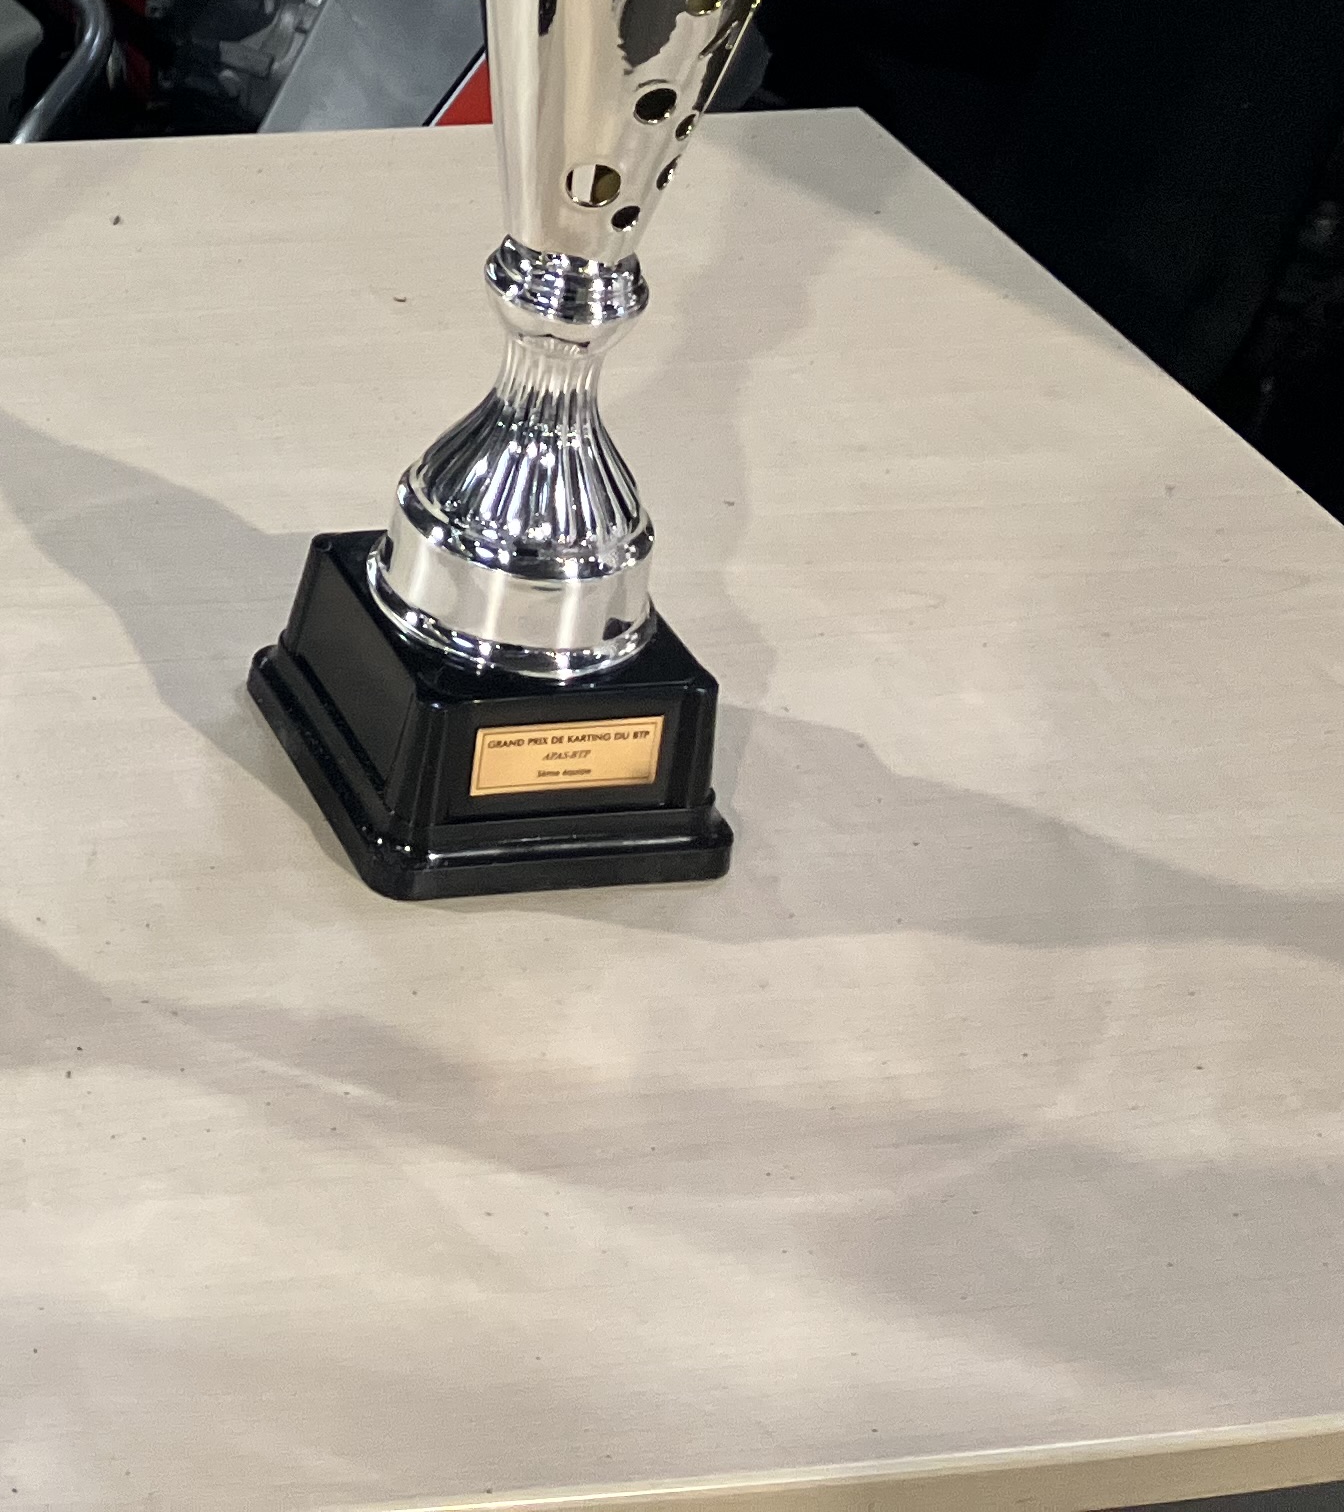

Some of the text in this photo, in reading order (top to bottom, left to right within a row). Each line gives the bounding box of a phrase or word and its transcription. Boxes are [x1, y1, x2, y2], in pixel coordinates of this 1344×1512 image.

[487, 730, 651, 749] GRAND PRIX DE KARTING DU BTP
[542, 749, 592, 761] APAS-BTP
